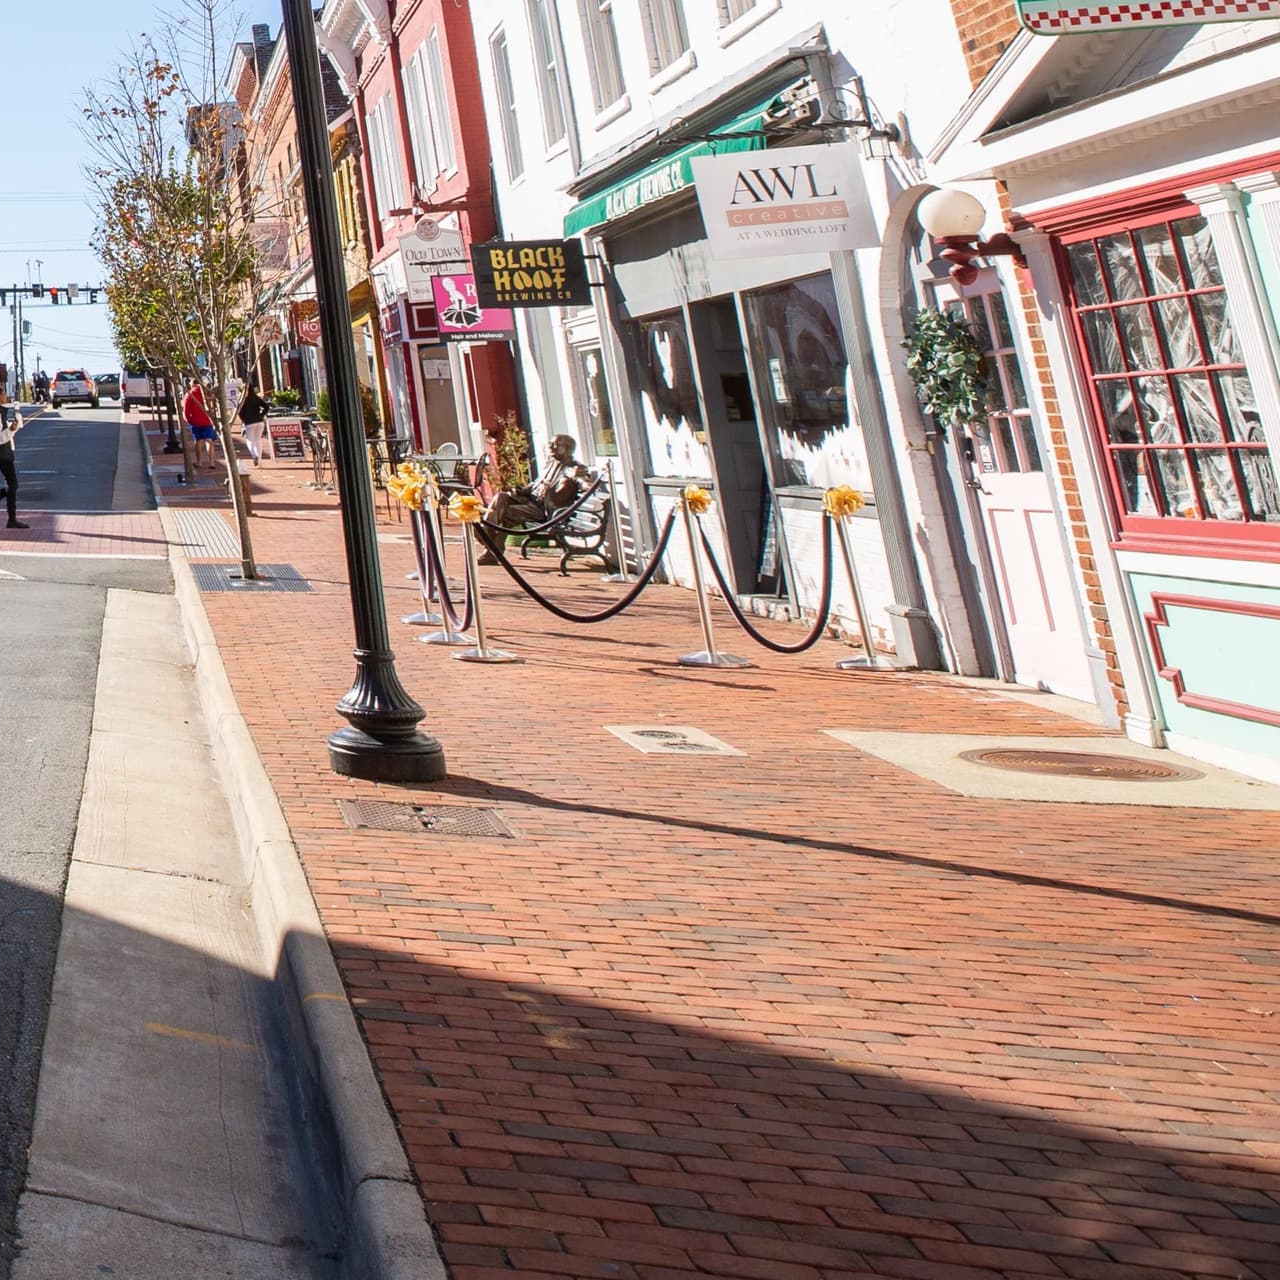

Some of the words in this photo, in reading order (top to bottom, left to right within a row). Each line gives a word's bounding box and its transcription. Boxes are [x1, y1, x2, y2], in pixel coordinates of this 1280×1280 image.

[730, 163, 838, 205] AWL
[732, 205, 843, 224] creative
[737, 232, 751, 240] AT
[754, 231, 761, 239] A
[761, 226, 817, 239] WEDDING
[820, 224, 848, 234] LOFT
[405, 249, 427, 261] OLD
[429, 248, 463, 259] TOWN
[490, 247, 565, 270] BLACK
[493, 268, 566, 291] HOOF
[497, 291, 552, 301] BREWING
[270, 424, 299, 432] ROUGE
